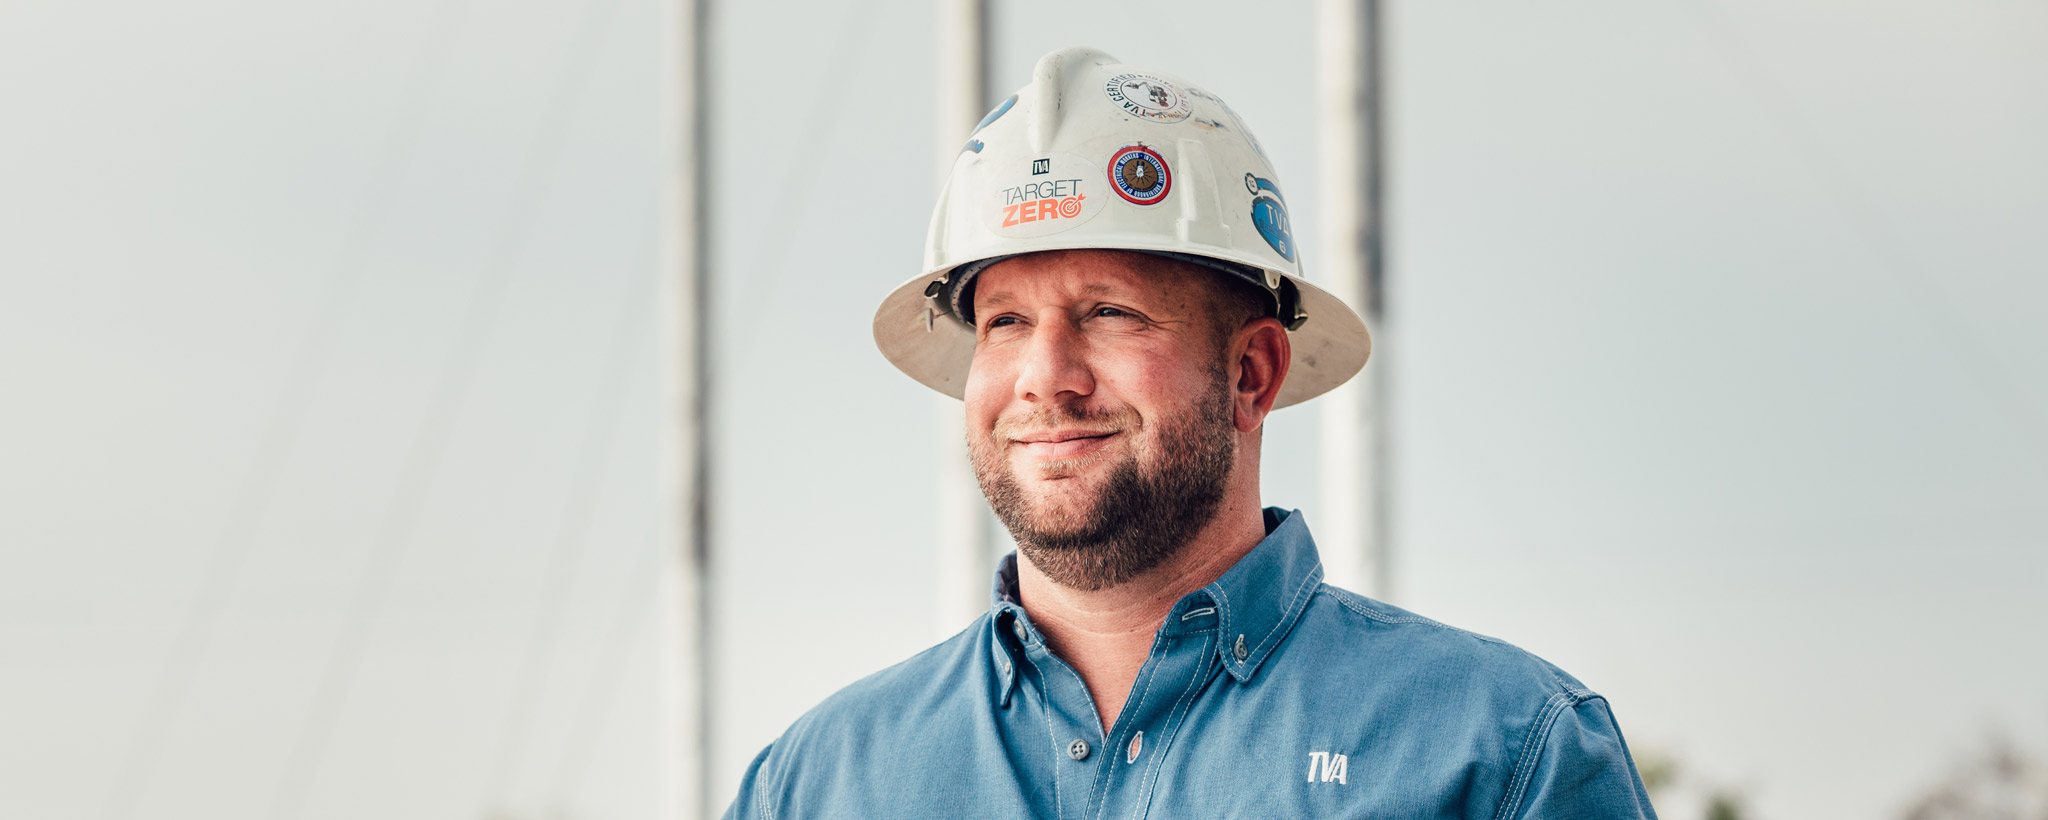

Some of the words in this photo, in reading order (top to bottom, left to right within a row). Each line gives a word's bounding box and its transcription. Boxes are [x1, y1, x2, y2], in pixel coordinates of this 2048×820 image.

[1106, 73, 1137, 102] CERTIFIED
[1123, 101, 1147, 117] TVA
[1033, 160, 1049, 174] TVA
[1002, 179, 1083, 205] TARGET
[1001, 196, 1083, 228] ZERO
[1266, 203, 1290, 237] TVA
[1308, 751, 1348, 785] TVA
